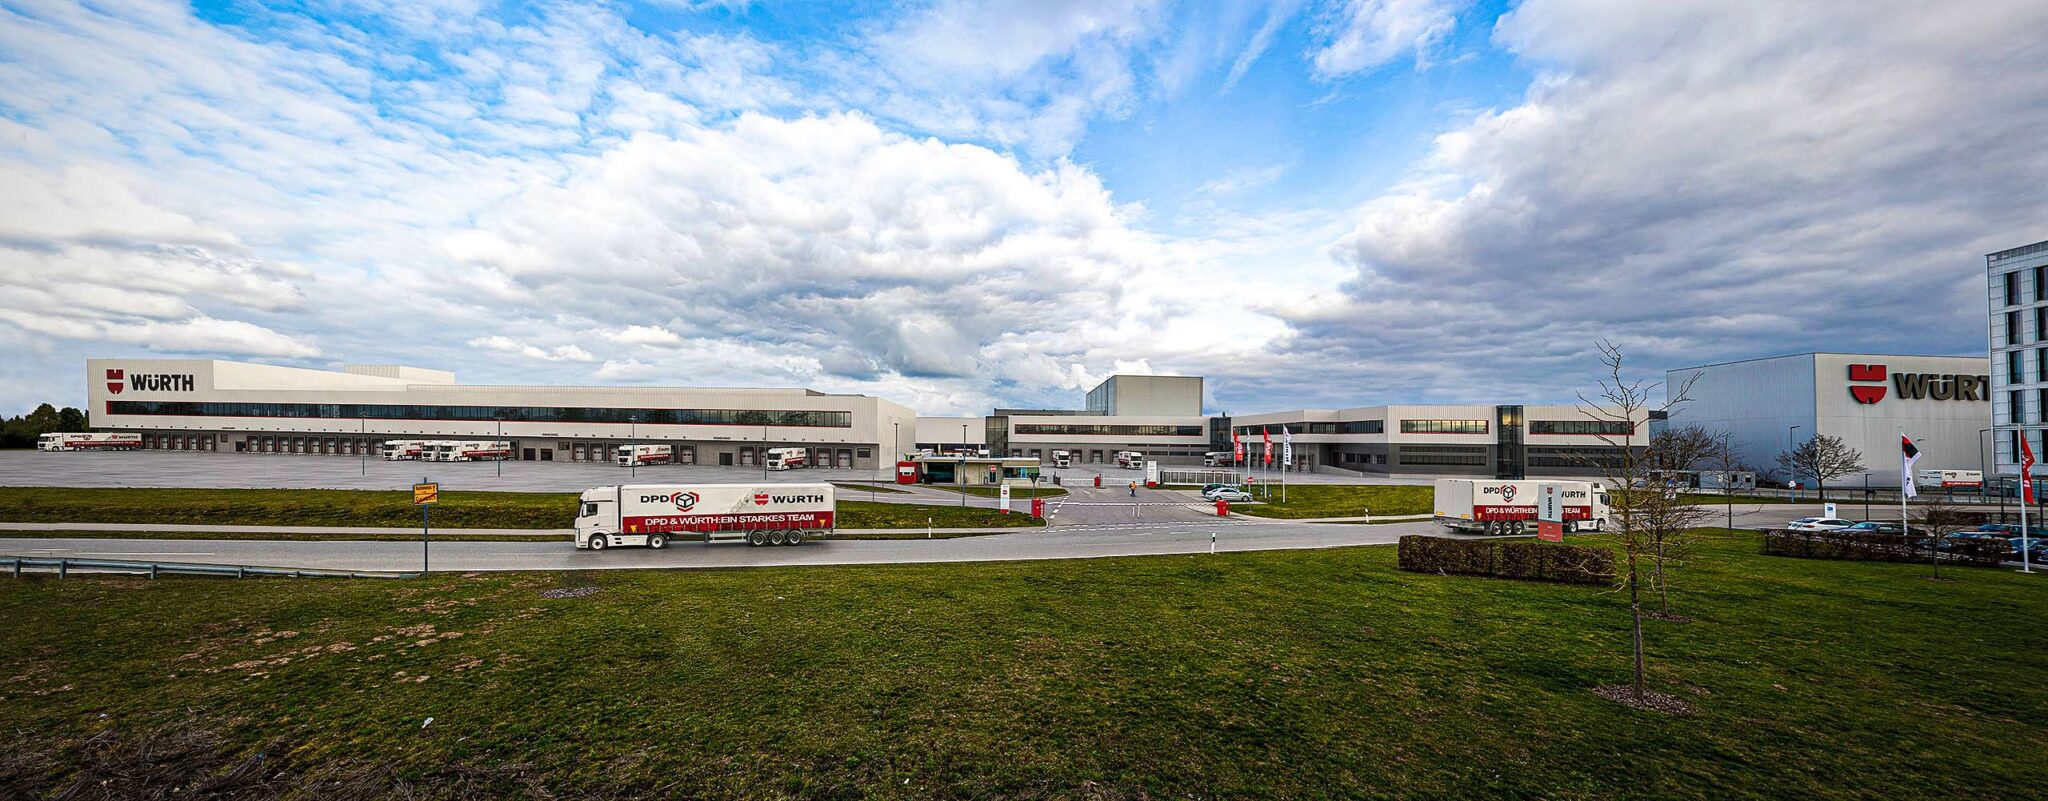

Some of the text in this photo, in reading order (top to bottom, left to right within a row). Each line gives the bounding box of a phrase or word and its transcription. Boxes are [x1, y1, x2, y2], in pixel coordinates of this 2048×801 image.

[130, 374, 194, 391] WÜRTH
[640, 495, 670, 503] DPD
[772, 494, 824, 504] WÜRTH
[645, 518, 668, 526] DPD
[670, 517, 678, 525] &
[739, 514, 786, 523] STARKES
[787, 513, 815, 522] TEAM
